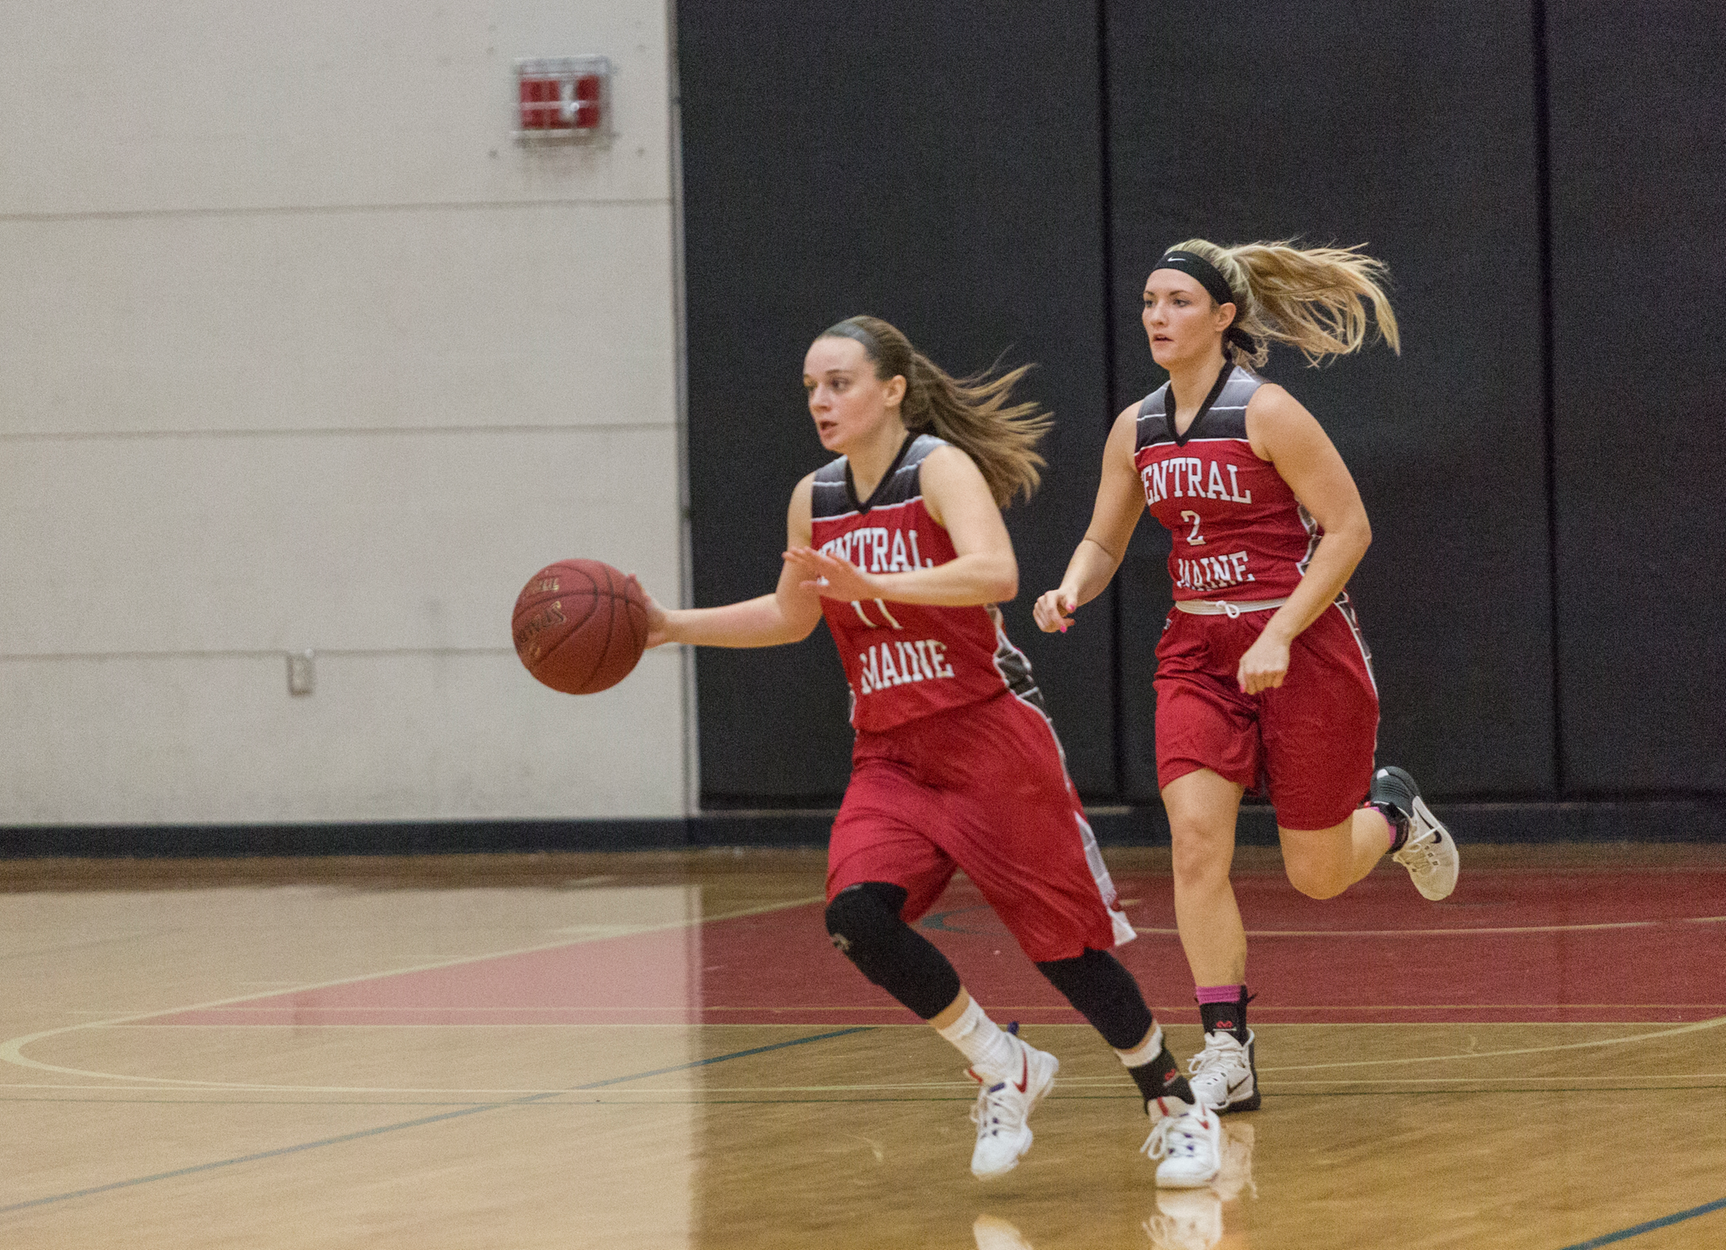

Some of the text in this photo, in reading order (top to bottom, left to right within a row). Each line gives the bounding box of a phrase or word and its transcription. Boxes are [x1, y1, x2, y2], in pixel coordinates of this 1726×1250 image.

[1141, 457, 1252, 506] ENTRAL
[817, 526, 934, 573] NTRAL
[1180, 510, 1206, 546] 2
[1176, 551, 1256, 591] MAINE
[859, 638, 955, 695] MAINE
